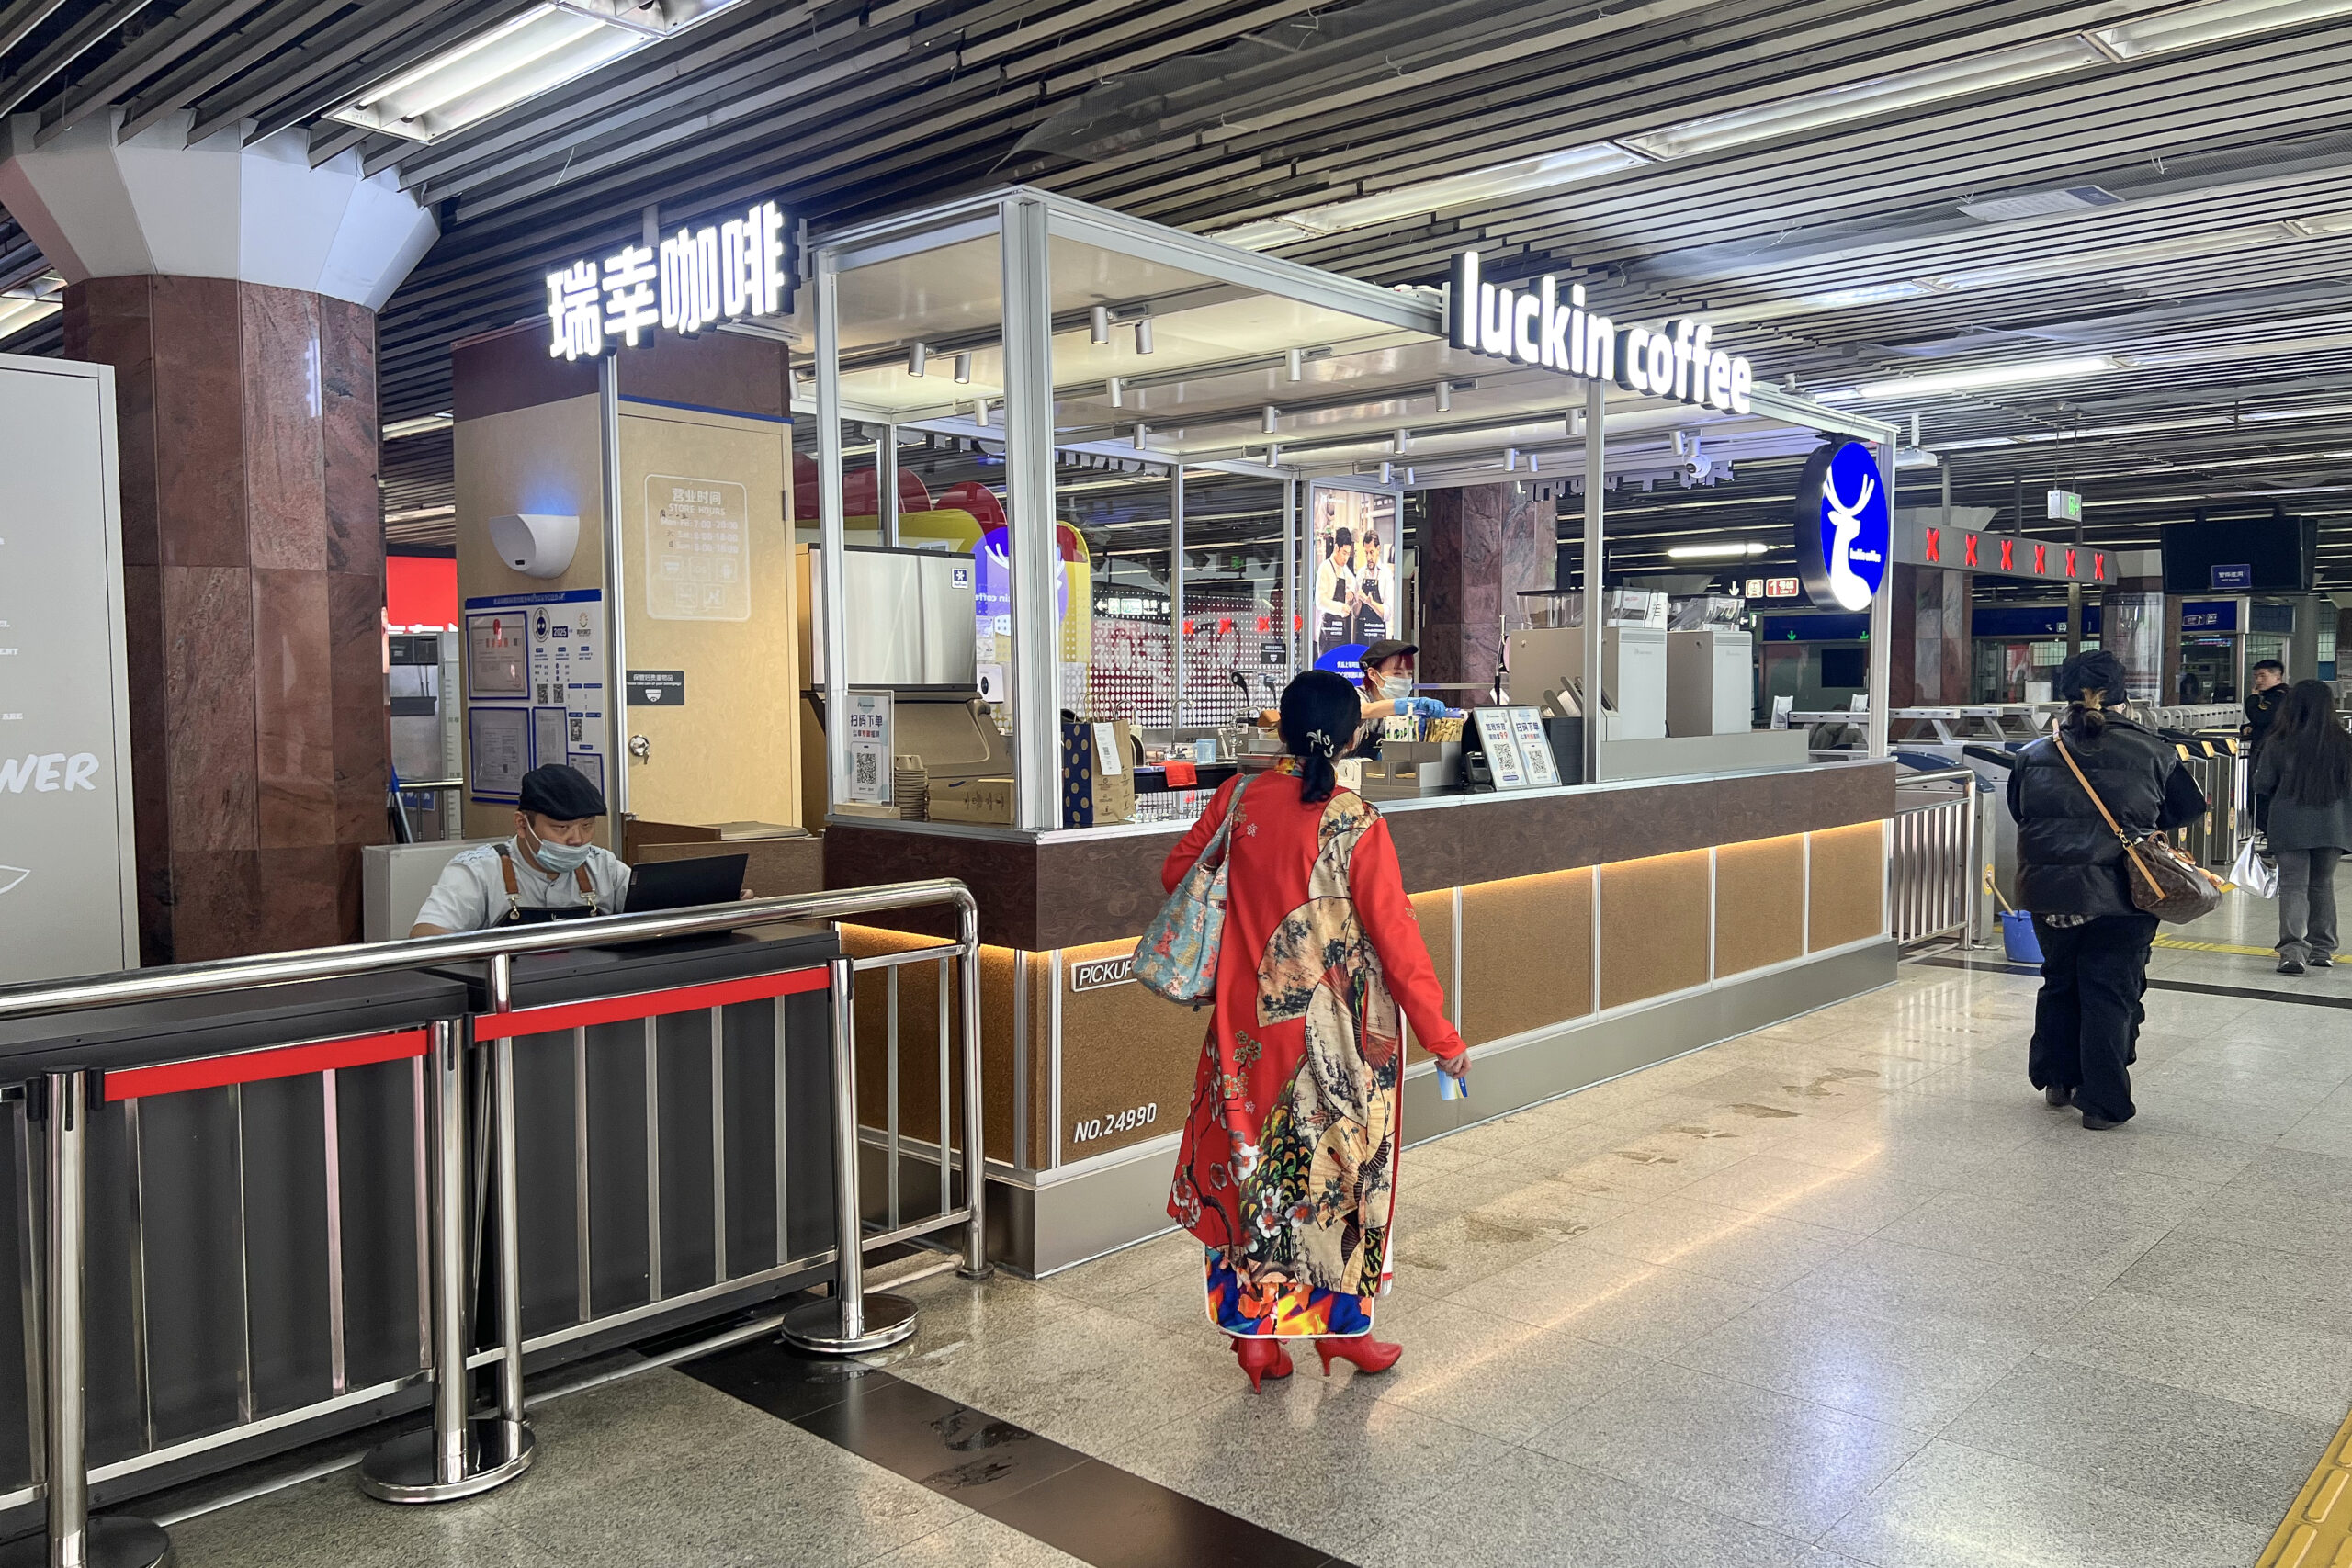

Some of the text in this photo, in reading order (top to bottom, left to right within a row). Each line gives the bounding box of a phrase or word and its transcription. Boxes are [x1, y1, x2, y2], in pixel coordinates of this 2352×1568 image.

[547, 199, 785, 361] 瑞幸咖啡
[1464, 251, 1751, 414] luckin coffee
[672, 488, 721, 505] 营业时间
[669, 503, 726, 516] STORE HOURS
[553, 627, 567, 637] 2025
[850, 714, 882, 728] 扫码下单
[1516, 721, 1540, 732] 扫码下单
[1074, 1102, 1158, 1143] NO.24990
